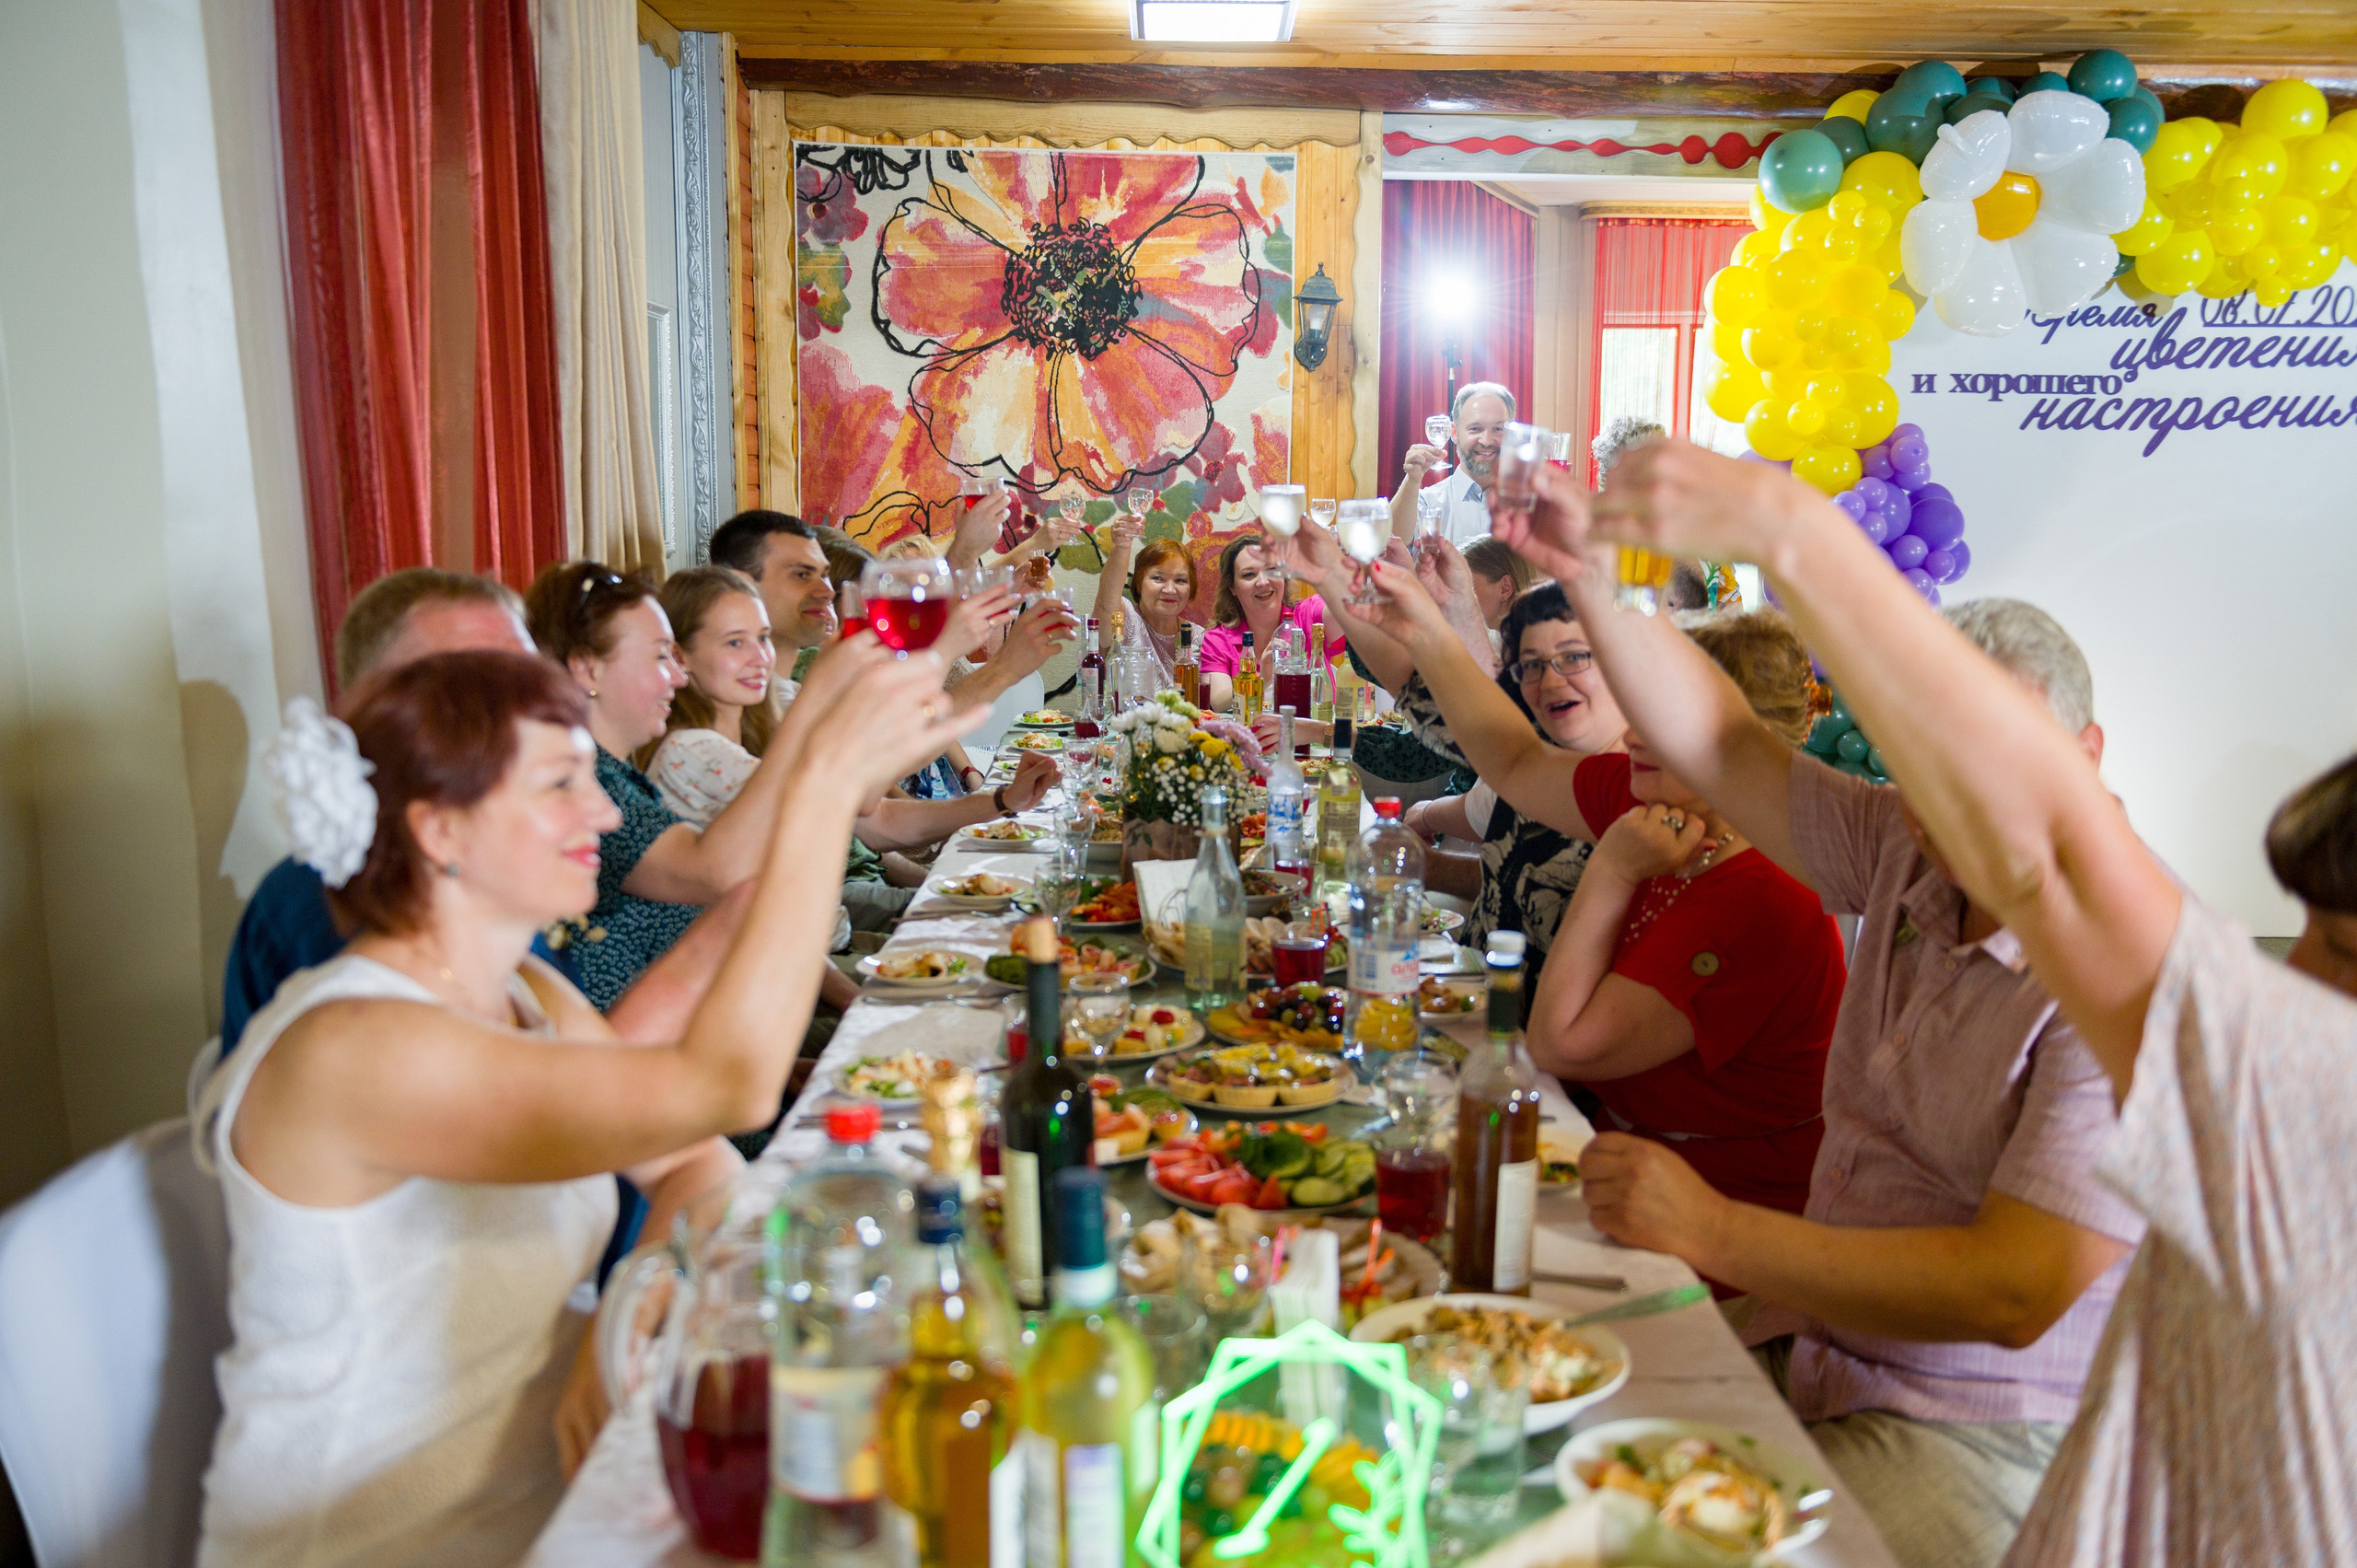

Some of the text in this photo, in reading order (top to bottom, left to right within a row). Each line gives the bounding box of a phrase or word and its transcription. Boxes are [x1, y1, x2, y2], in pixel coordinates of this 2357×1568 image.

[2023, 305, 2164, 345] ремя
[1910, 373, 2123, 401] и хорошего
